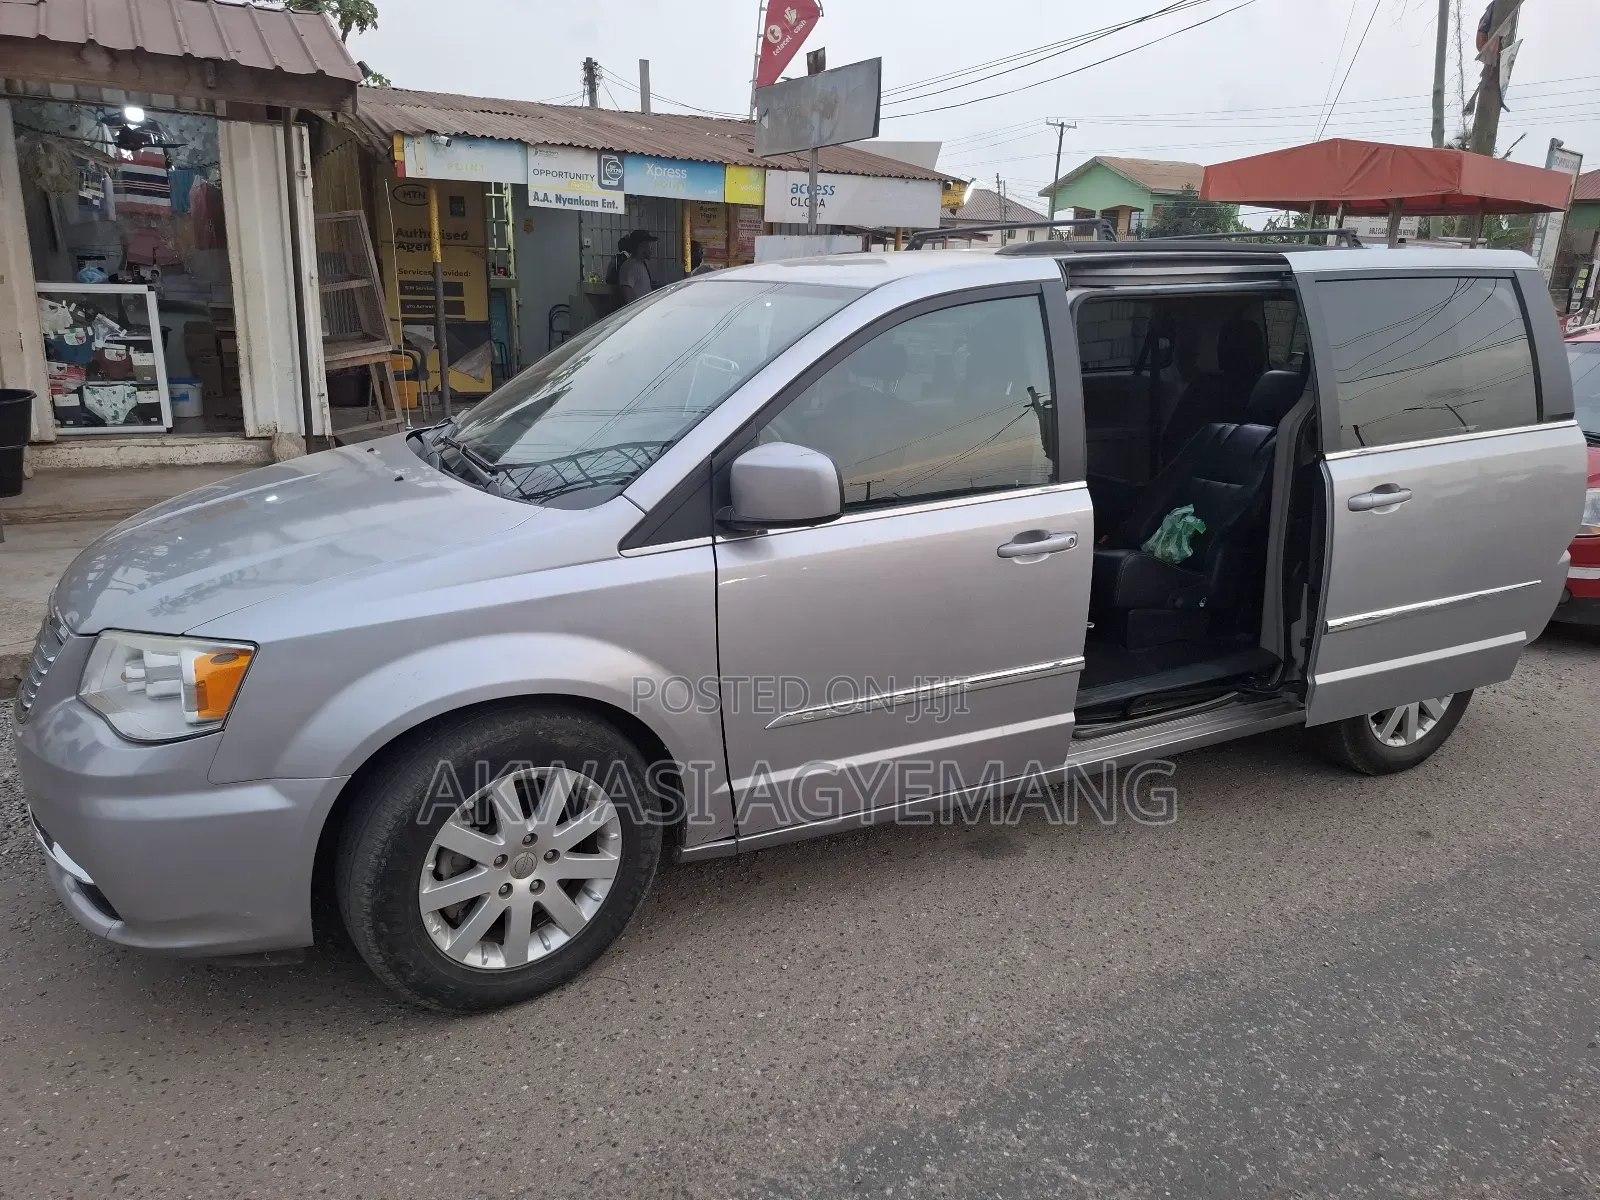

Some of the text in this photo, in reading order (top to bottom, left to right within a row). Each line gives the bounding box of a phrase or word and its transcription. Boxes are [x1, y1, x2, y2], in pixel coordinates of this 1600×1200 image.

[793, 20, 807, 34] cash
[447, 163, 485, 173] POINT
[645, 163, 687, 179] Xpress
[532, 168, 596, 182] OPPORTUNITY
[403, 190, 427, 200] MTN
[533, 191, 619, 209] A.A. Nyankom Ent.
[790, 196, 826, 208] CLOA
[396, 227, 469, 240] Authised
[397, 241, 431, 253] Agen
[398, 267, 432, 276] Services
